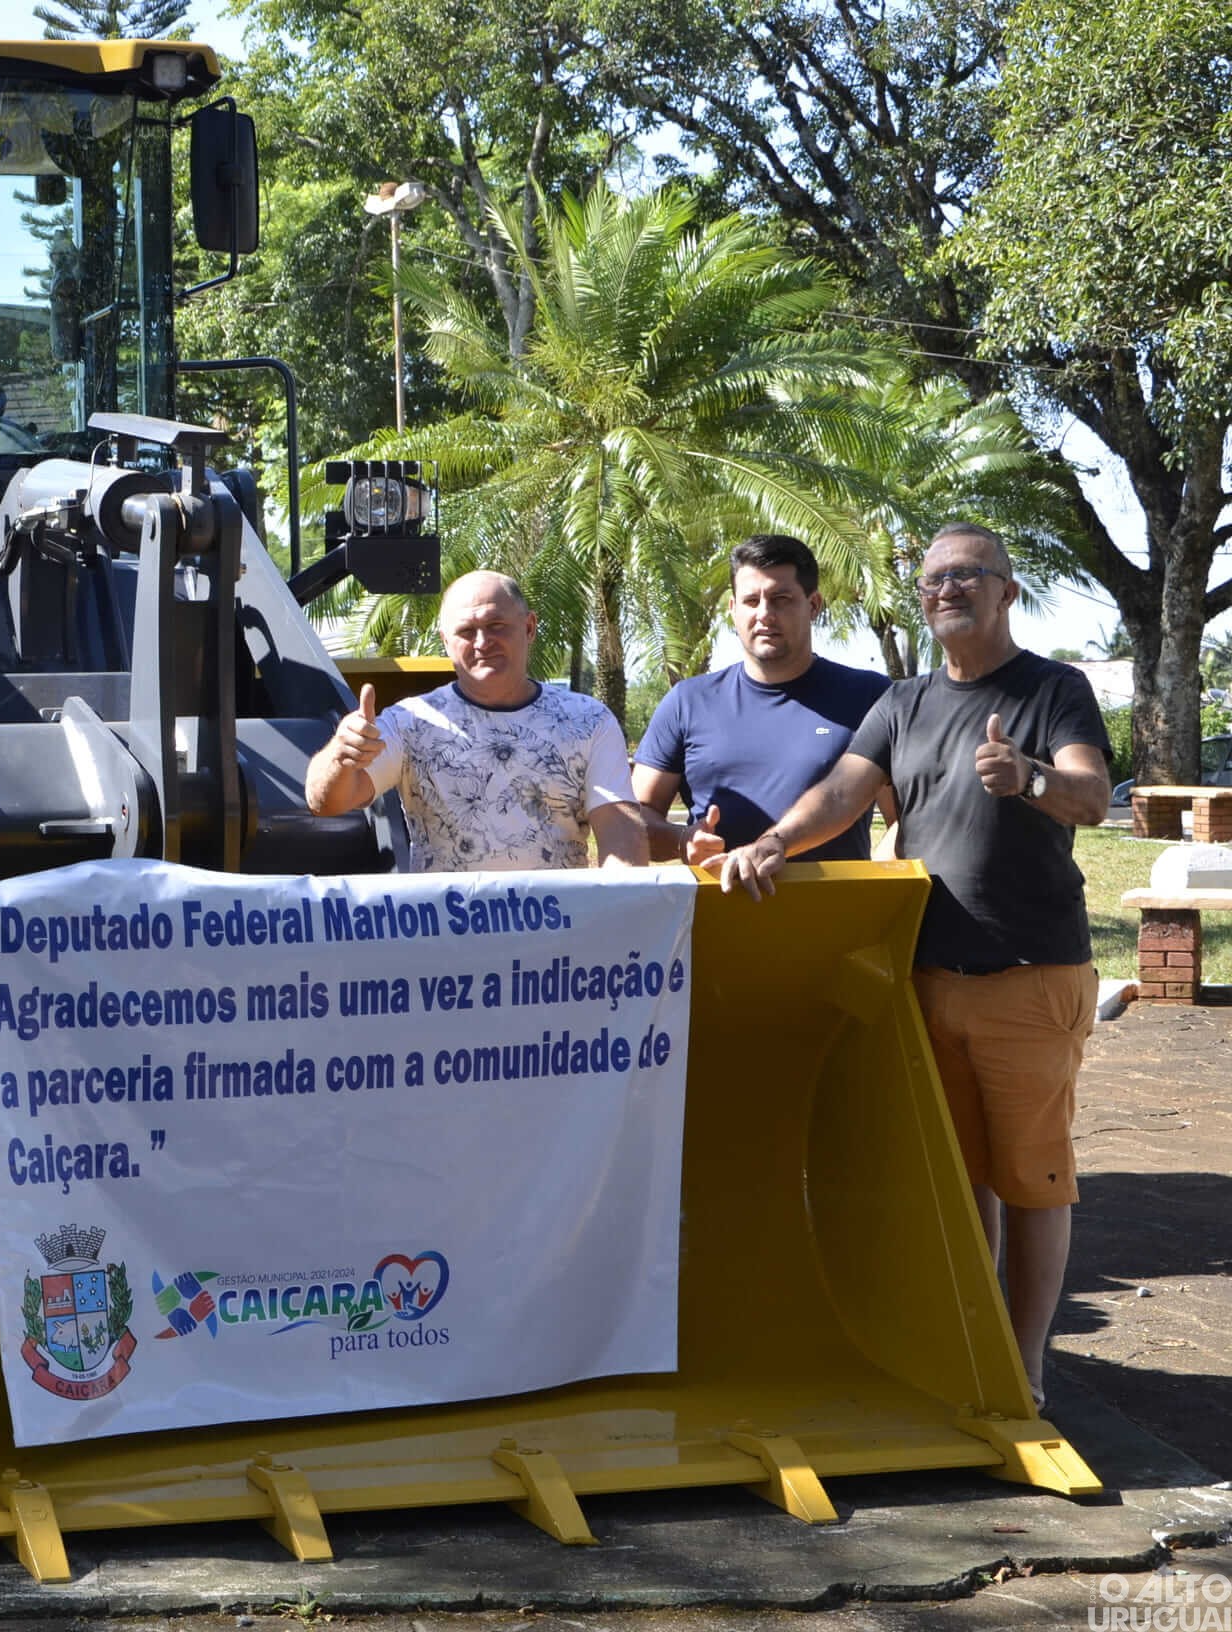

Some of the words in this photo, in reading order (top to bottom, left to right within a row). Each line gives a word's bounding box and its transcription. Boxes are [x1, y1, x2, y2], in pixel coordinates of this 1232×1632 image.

[0, 902, 174, 964] Deputado
[182, 897, 314, 948] Federal
[321, 895, 440, 942] Marlon
[445, 887, 572, 936] Santos.
[247, 970, 330, 1022] mais
[339, 977, 410, 1017] uma
[418, 974, 474, 1012] vez
[482, 972, 502, 1009] a
[511, 950, 665, 1012] indicação
[668, 957, 685, 993] e
[0, 1071, 20, 1109] a
[27, 1053, 174, 1117] parceria
[183, 1048, 317, 1100] firmada
[325, 1053, 395, 1093] com
[404, 1051, 424, 1088] a
[433, 1027, 631, 1085] comunidade
[638, 1023, 671, 1070] de
[7, 1134, 141, 1196] Caiçara.
[218, 1279, 385, 1323] CAIÇARA
[258, 1271, 309, 1285] MUNICIPAL
[310, 1267, 356, 1281] 2021/2024
[329, 1331, 379, 1360] para
[388, 1323, 450, 1348] todos
